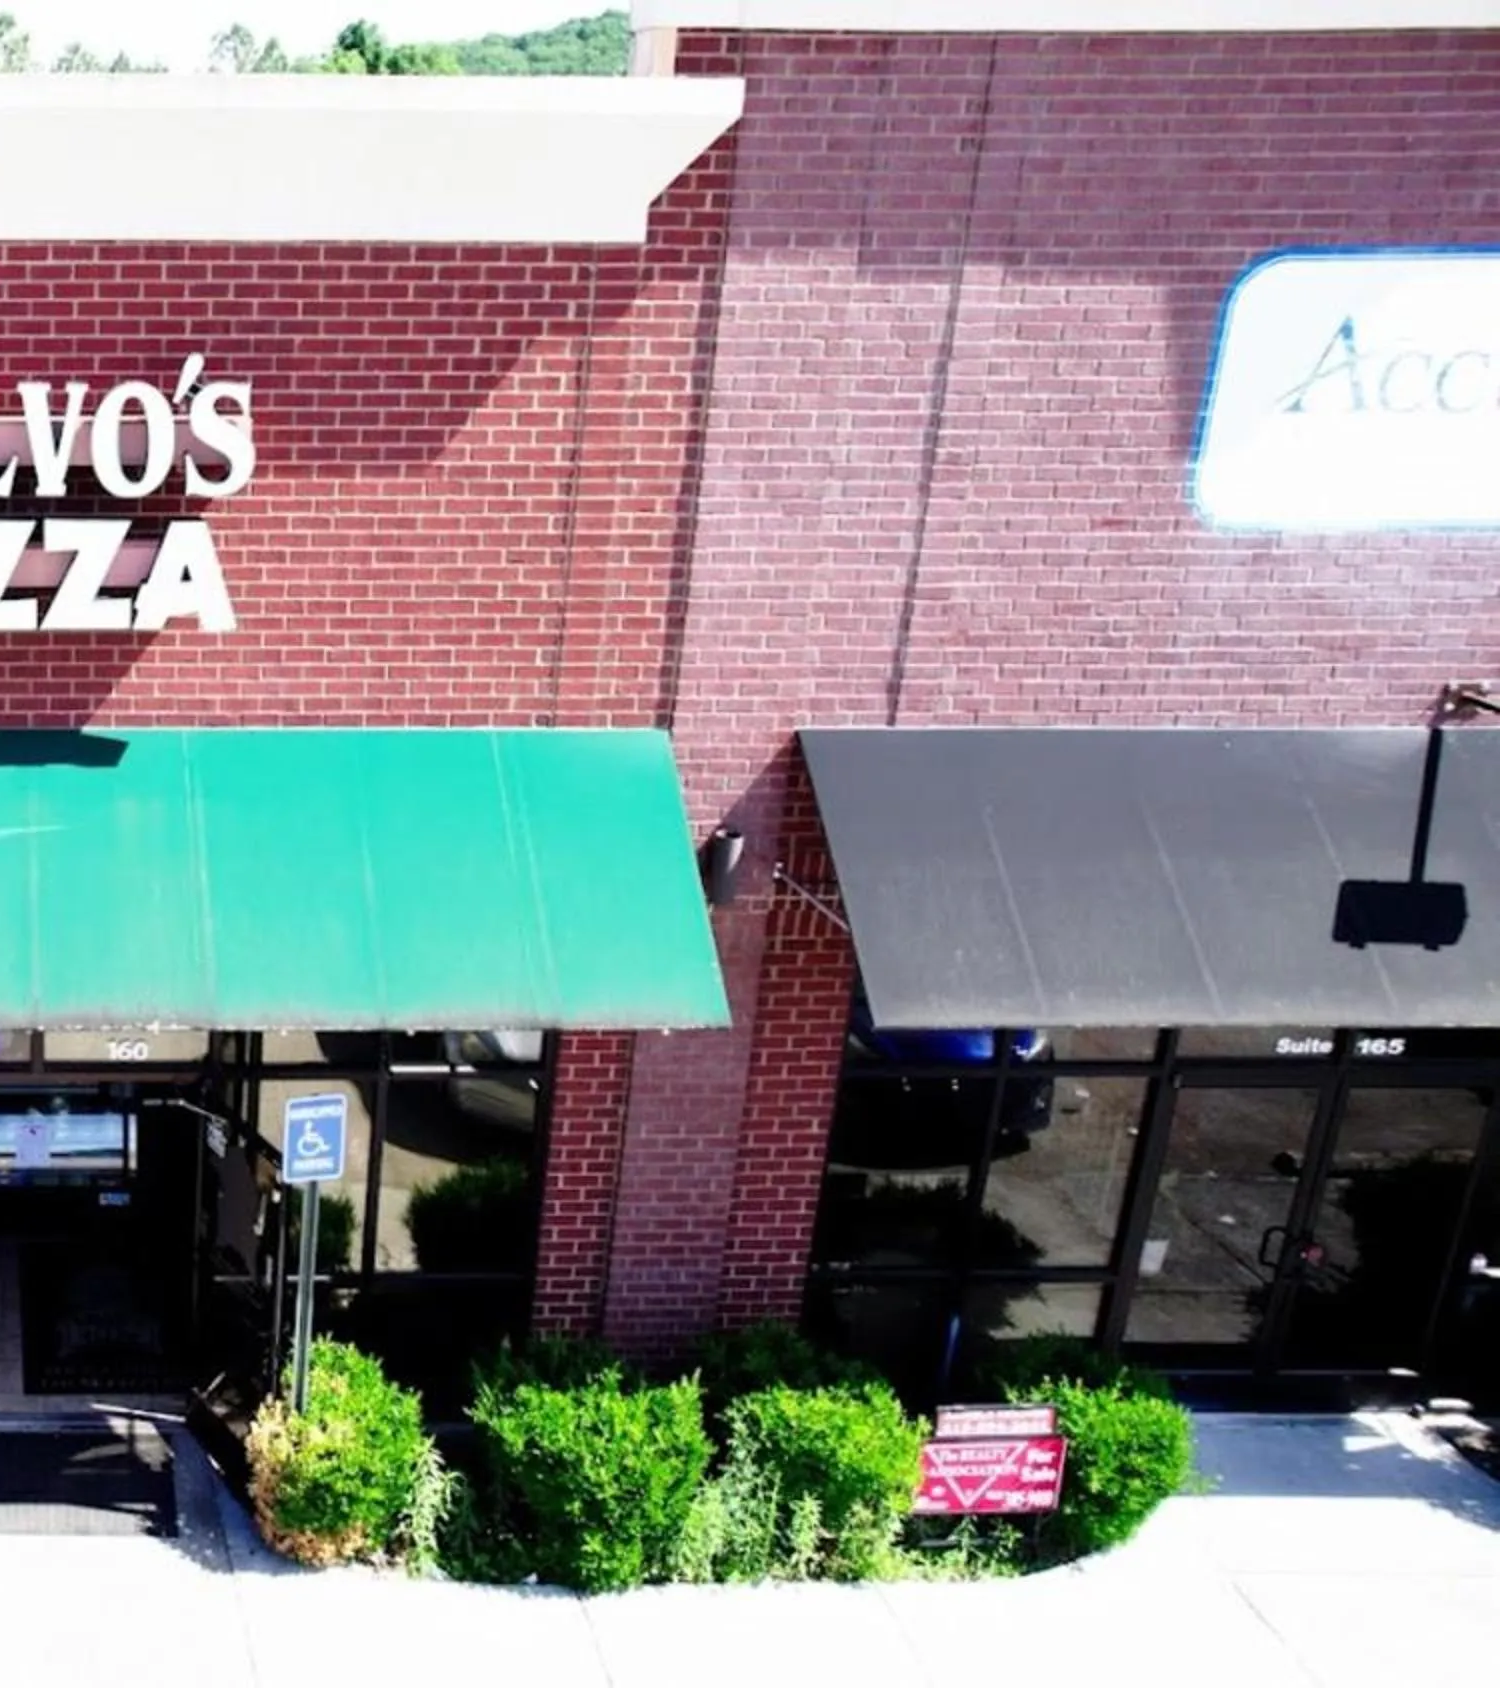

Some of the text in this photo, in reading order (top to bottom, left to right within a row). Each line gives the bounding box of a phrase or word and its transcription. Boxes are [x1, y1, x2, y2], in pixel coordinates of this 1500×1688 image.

[106, 1041, 148, 1060] 160
[1276, 1037, 1407, 1055] Suite 165
[1027, 1448, 1057, 1464] For
[1020, 1466, 1057, 1482] Sale
